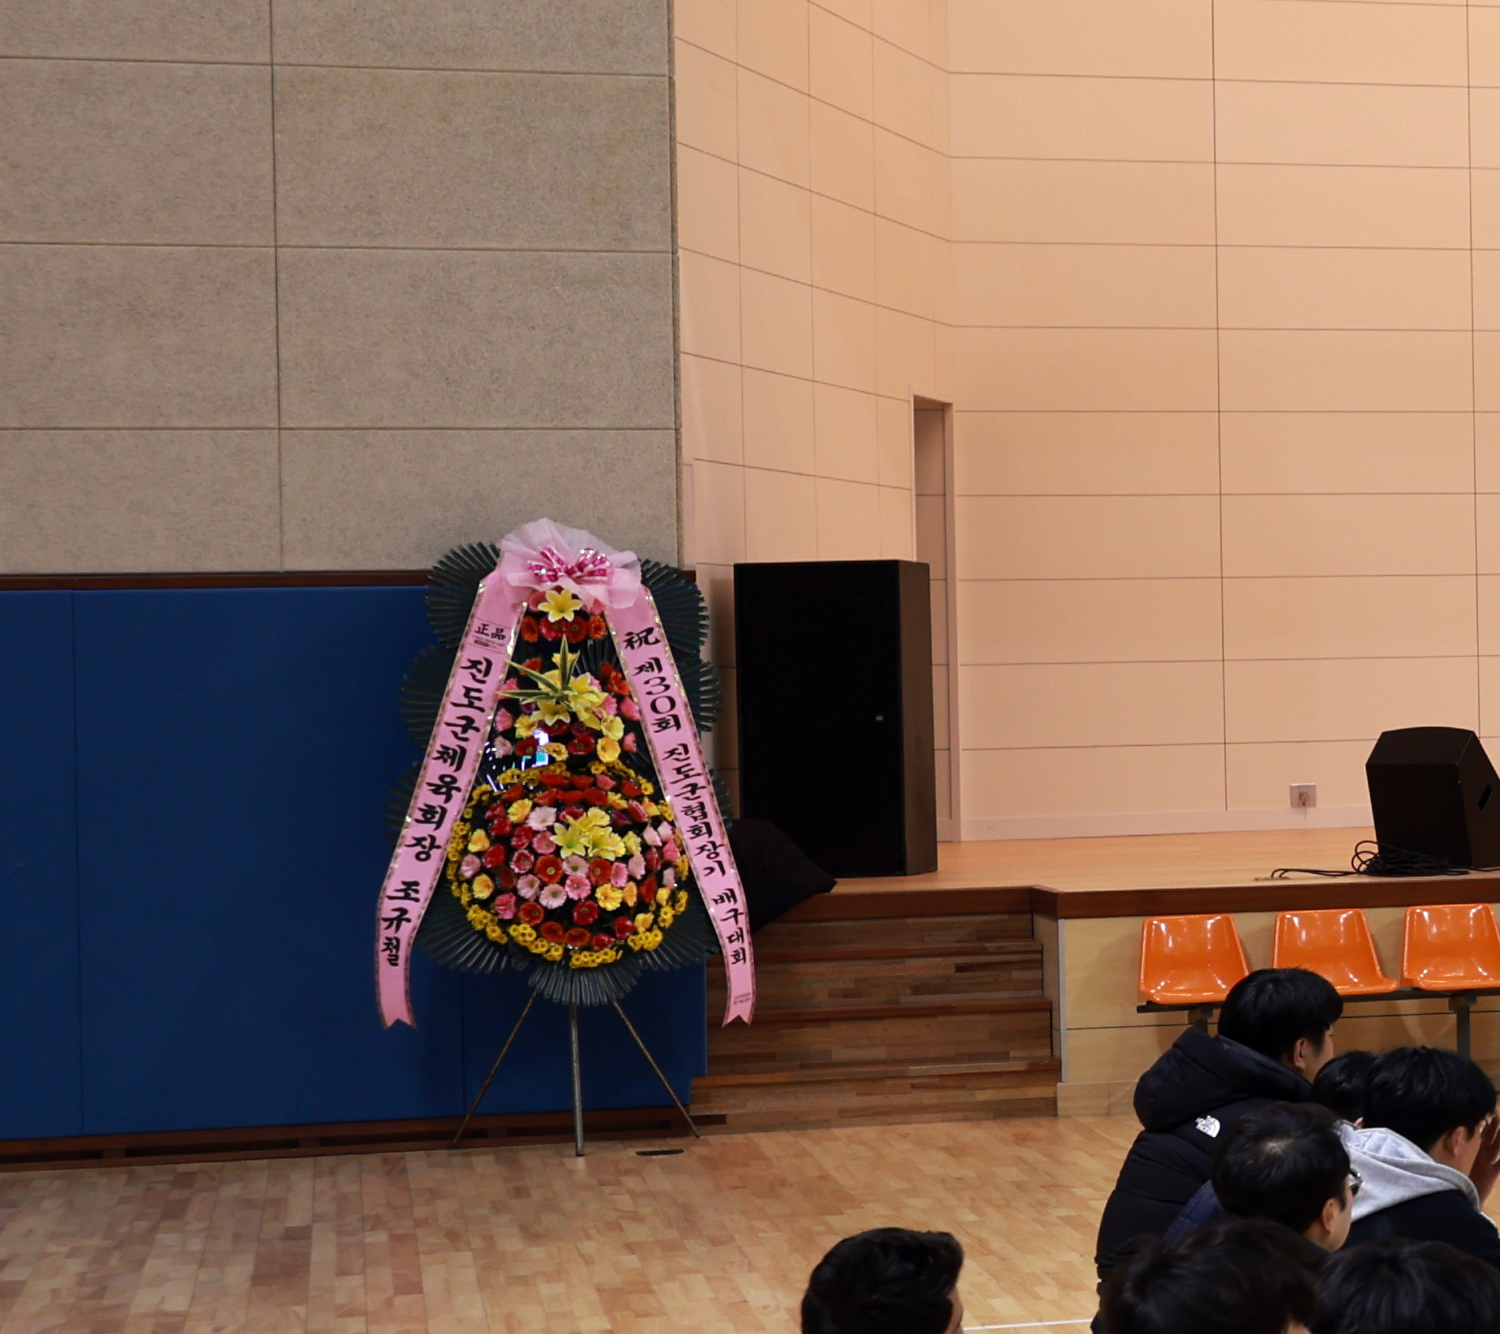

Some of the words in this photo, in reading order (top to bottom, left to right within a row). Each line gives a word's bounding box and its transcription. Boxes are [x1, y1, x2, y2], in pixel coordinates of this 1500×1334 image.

[623, 626, 661, 651] 祝
[405, 656, 494, 863] 진도군체육회장
[632, 655, 682, 734] 제30회
[661, 743, 728, 878] 진도군협회장기
[710, 886, 748, 966] 배구대회
[381, 879, 421, 967] 조규철
